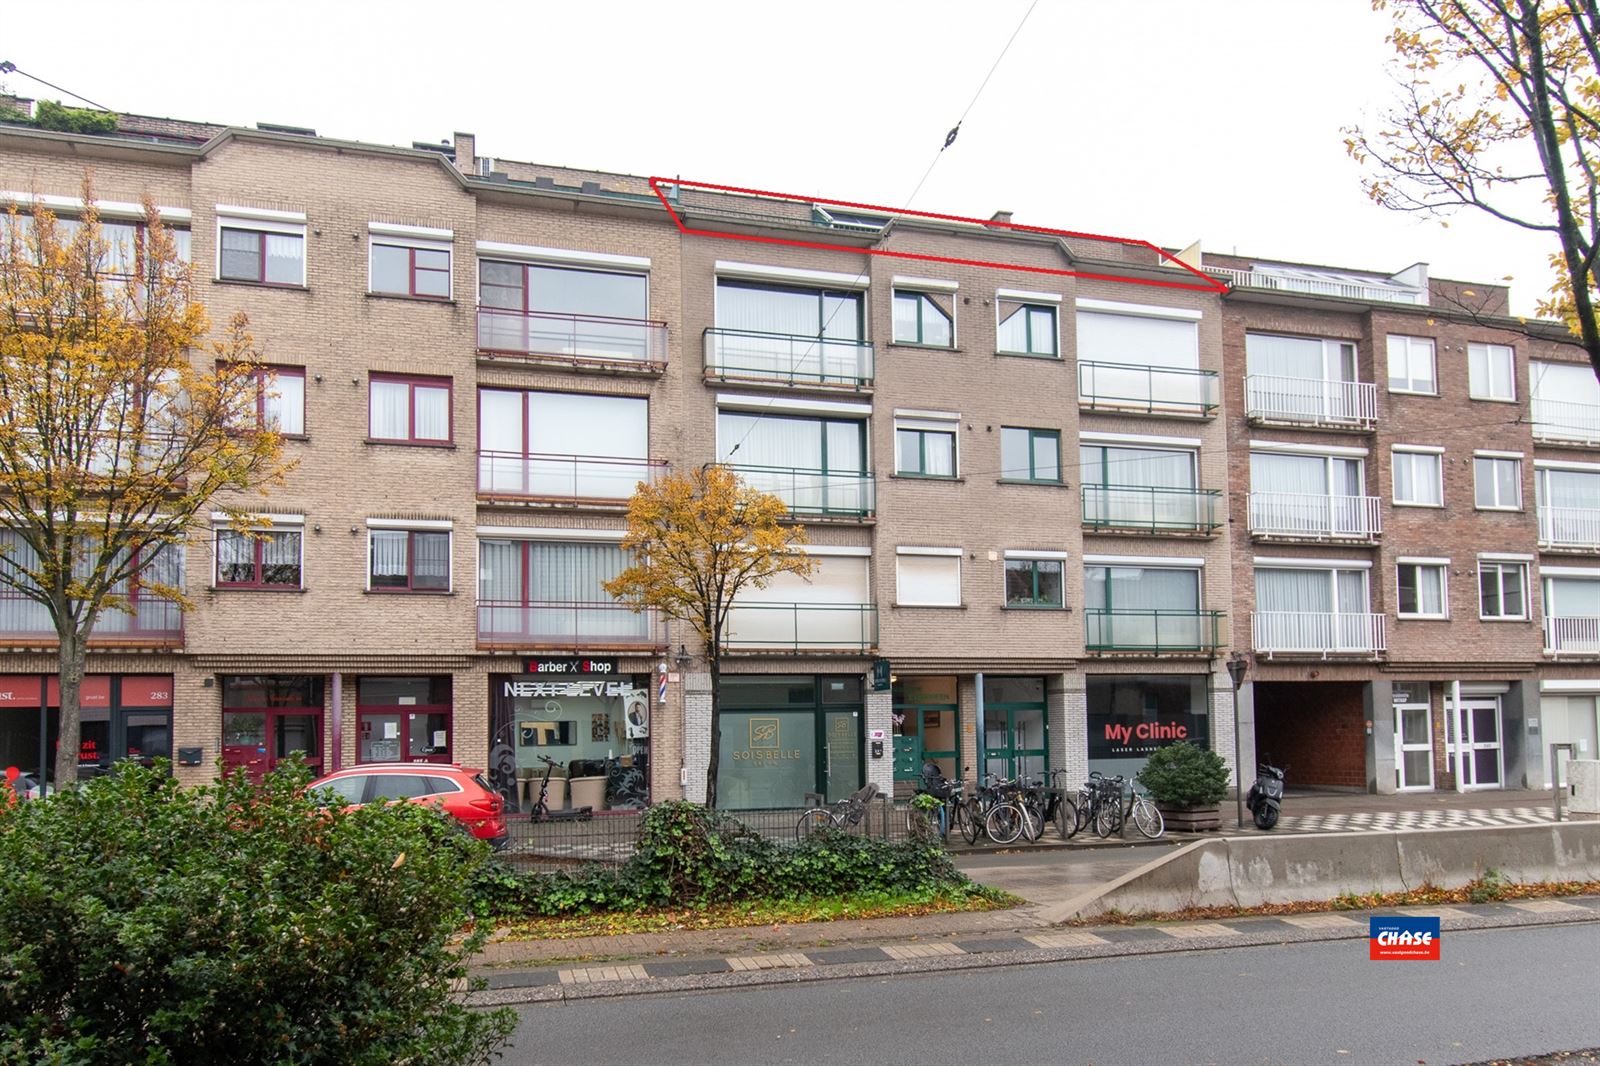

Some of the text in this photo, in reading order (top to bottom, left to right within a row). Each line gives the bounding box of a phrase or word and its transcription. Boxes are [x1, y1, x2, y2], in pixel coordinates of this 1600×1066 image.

[529, 660, 567, 673] Barber
[582, 660, 612, 674] Shop
[150, 691, 168, 700] 283
[504, 681, 560, 697] NEXT
[1105, 721, 1187, 745] My Clinic
